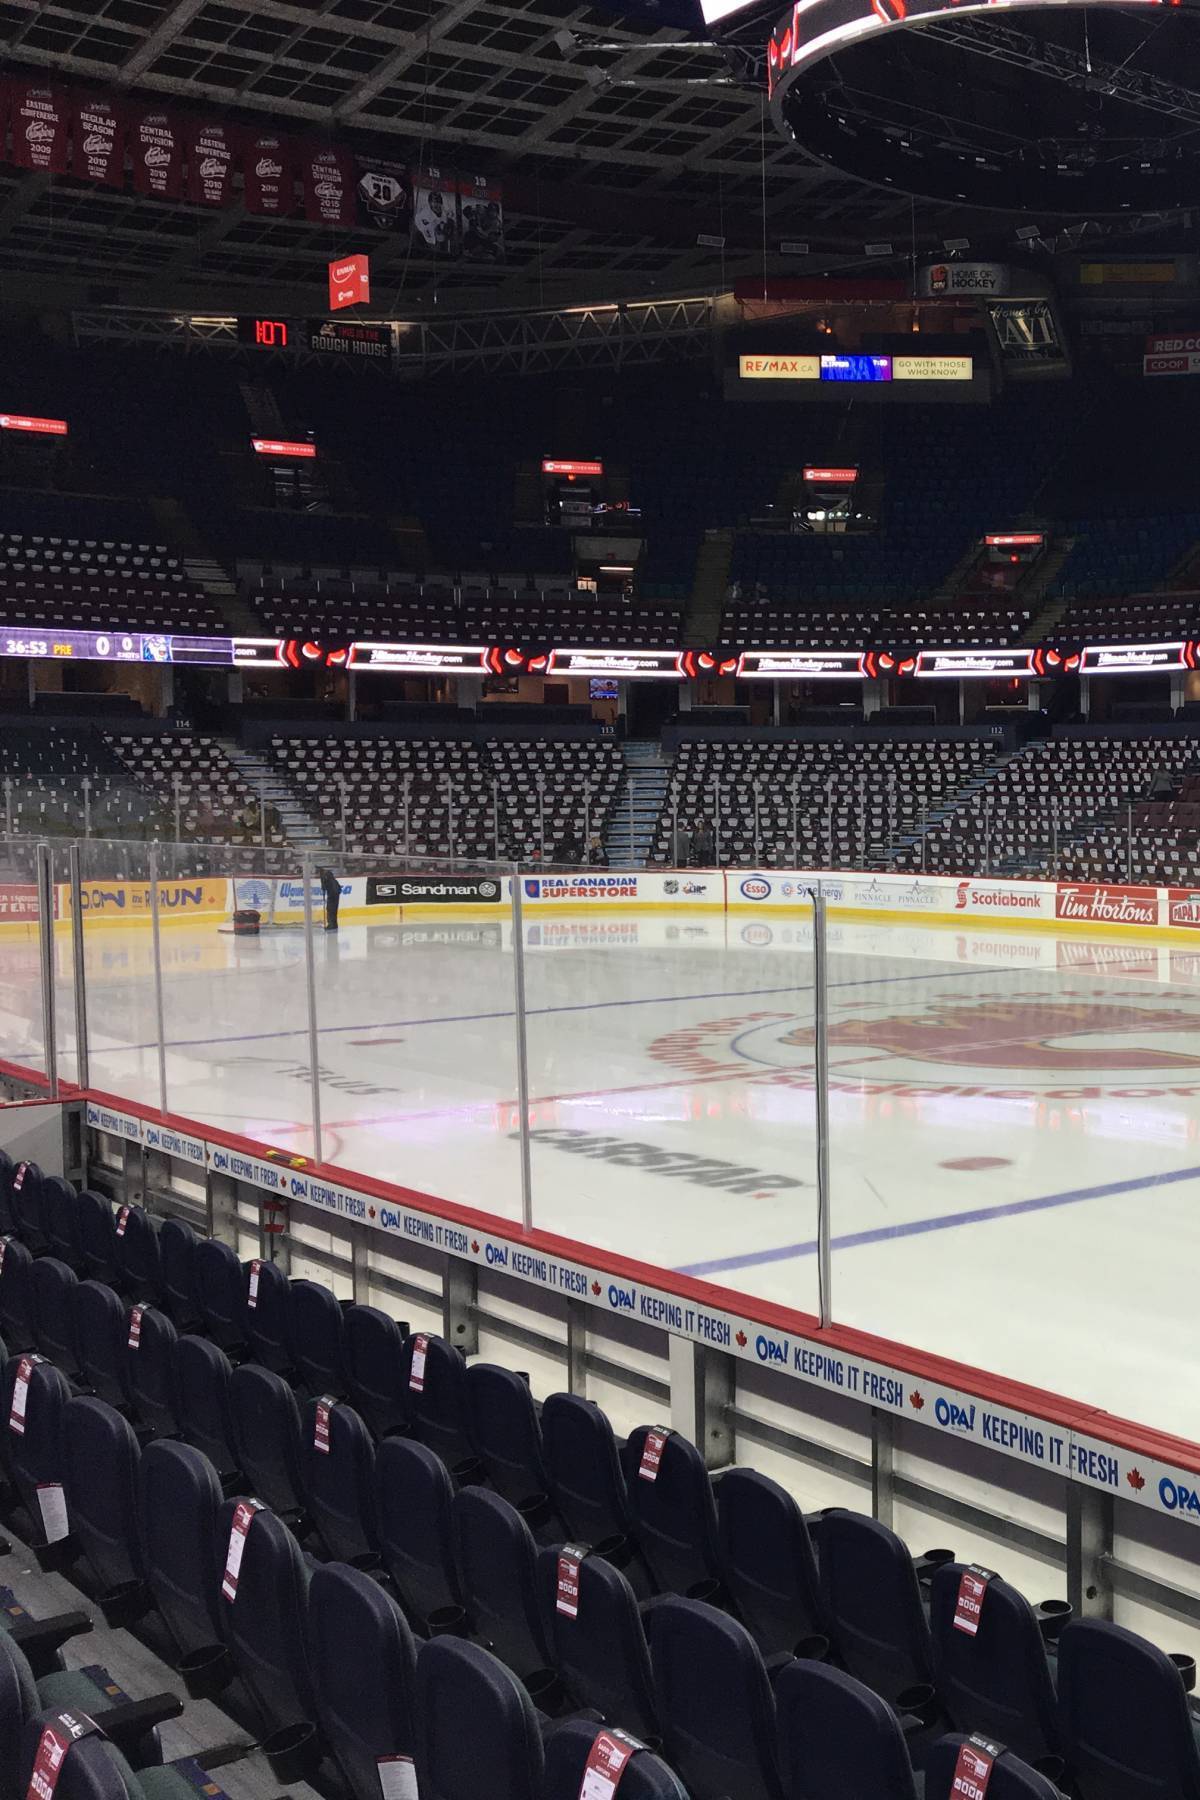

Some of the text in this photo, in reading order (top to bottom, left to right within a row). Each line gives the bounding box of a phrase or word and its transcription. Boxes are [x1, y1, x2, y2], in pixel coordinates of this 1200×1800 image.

[80, 111, 116, 128] REGULAR
[83, 121, 114, 136] SEASON
[140, 126, 173, 138] CENTRAL
[140, 134, 174, 148] DIVISION
[30, 143, 51, 154] 2009
[88, 156, 107, 167] 2010
[150, 169, 167, 179] 2010
[312, 164, 341, 175] CENTRAL
[312, 171, 342, 183] DIVISION
[204, 180, 222, 190] 2010
[261, 184, 278, 193] 2010
[373, 183, 391, 202] 20
[337, 263, 356, 276] ENMAX
[952, 270, 993, 278] HOME OF
[952, 279, 996, 289] HOCKEY
[312, 335, 388, 357] ROUGH HOUSE
[1154, 339, 1183, 352] RED
[938, 361, 967, 369] THOSE
[908, 370, 928, 378] WHO
[7, 640, 73, 656] 36:53 PRE
[96, 636, 110, 655] 0
[122, 637, 133, 651] 0
[176, 720, 190, 728] 114
[601, 726, 615, 734] 113
[991, 727, 1003, 735] 112
[573, 878, 638, 887] CANADIAN
[745, 883, 766, 893] Esso
[401, 883, 478, 896] Sandman
[542, 886, 638, 898] SUPERSTORE
[854, 892, 891, 902] PINNACLE
[898, 895, 935, 905] PINNACLE
[972, 891, 1041, 909] Scotiabank
[1060, 887, 1155, 922] Tim Hortons
[1172, 904, 1193, 921] PAPA
[87, 1107, 138, 1137] OPA! KEEPING IT FRESH
[146, 1129, 203, 1161] OPA! KEEPING IT FRESH
[214, 1151, 279, 1188] OPA! KEEPING IT FRESH
[290, 1178, 365, 1218] OPA! KEEPING IT FRESH
[380, 1207, 468, 1253] OPA! KEEPING IT FRESH
[485, 1243, 587, 1296] OPA! KEEPING IT FRESH
[608, 1284, 730, 1346] OPA! KEEPING IT FRESH
[755, 1335, 903, 1408] OPA! KEEPING IT FRESH
[935, 1397, 1119, 1487] OPA! KEEPING IT FRESH
